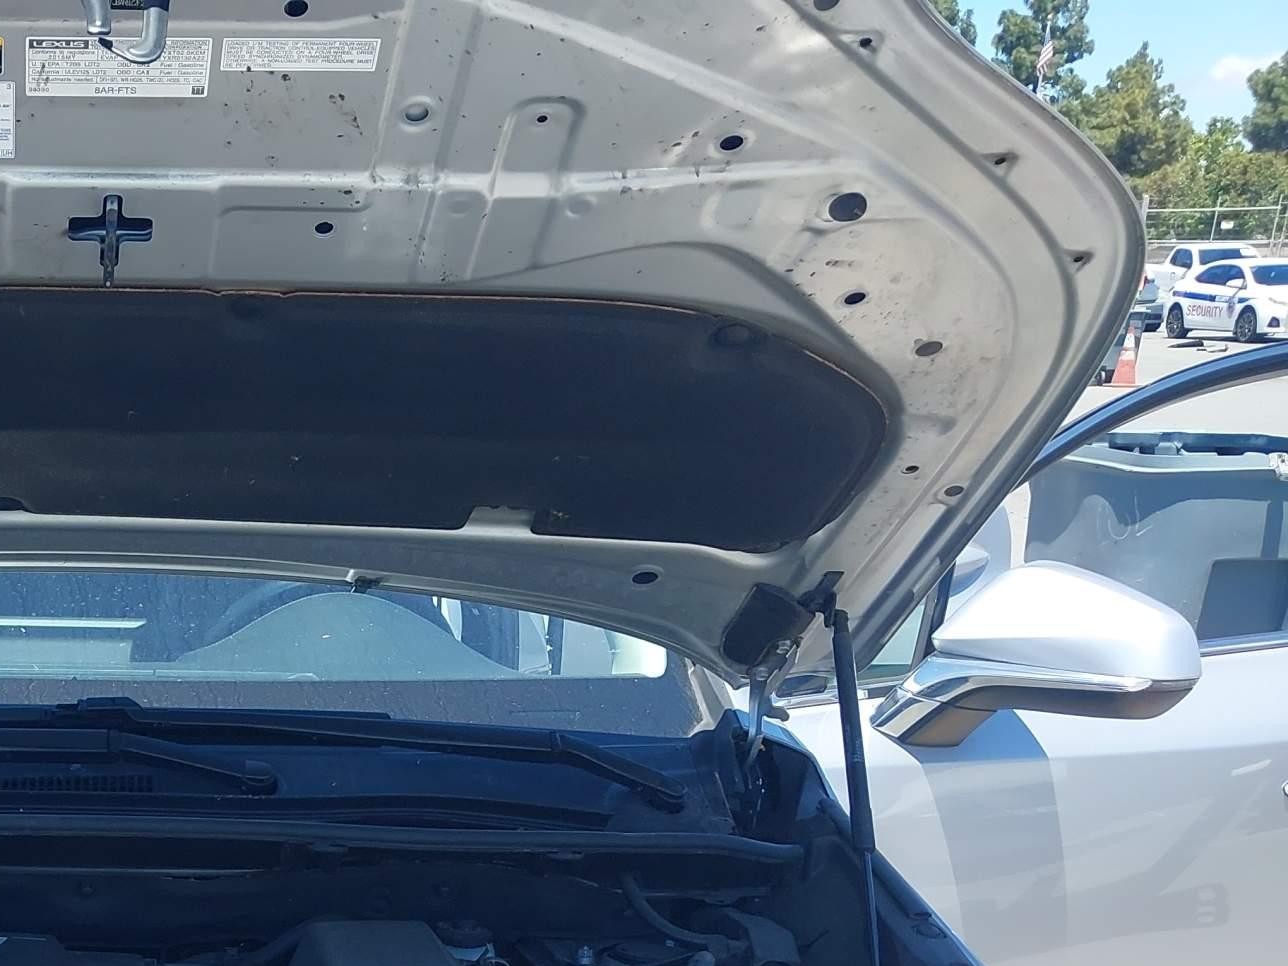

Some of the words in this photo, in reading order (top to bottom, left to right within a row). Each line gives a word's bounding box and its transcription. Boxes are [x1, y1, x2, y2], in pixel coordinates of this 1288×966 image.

[33, 40, 85, 48] LEXUS
[94, 86, 137, 94] 8AR-FTS
[1185, 304, 1224, 318] SECURITY
